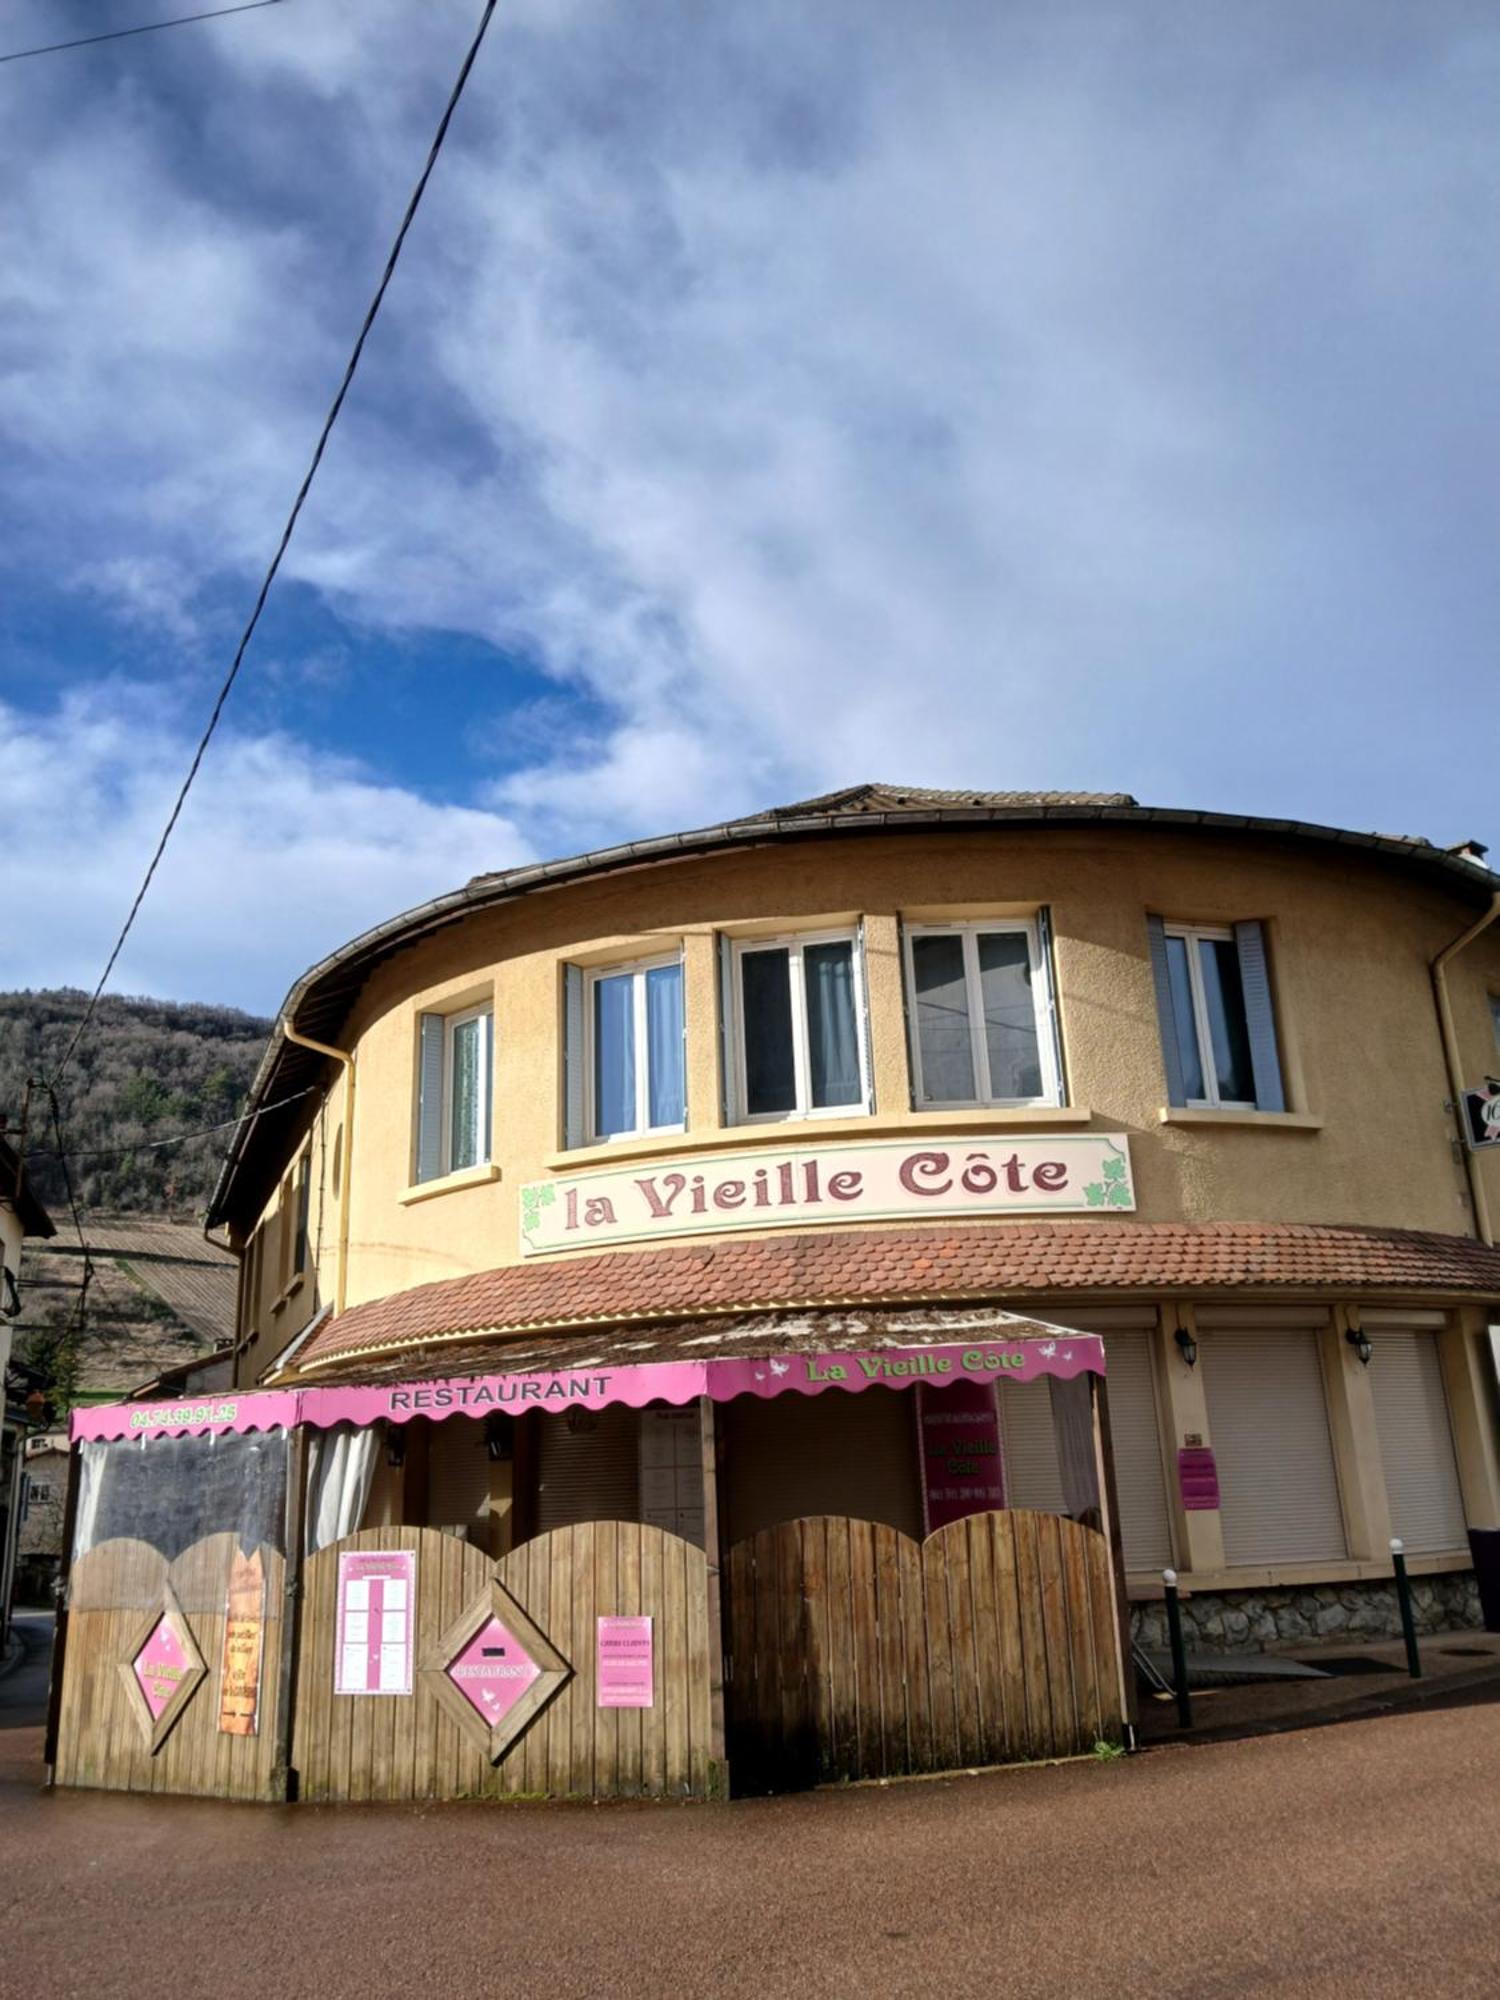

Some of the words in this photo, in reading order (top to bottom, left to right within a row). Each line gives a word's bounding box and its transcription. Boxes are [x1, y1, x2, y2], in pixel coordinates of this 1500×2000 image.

[564, 1188, 618, 1231] la
[634, 1158, 865, 1218] Vieille
[898, 1152, 1070, 1197] Côte
[806, 1360, 847, 1382] La
[857, 1353, 953, 1378] Vieille
[962, 1349, 1025, 1373] Côte
[389, 1376, 613, 1411] RESTAURANT
